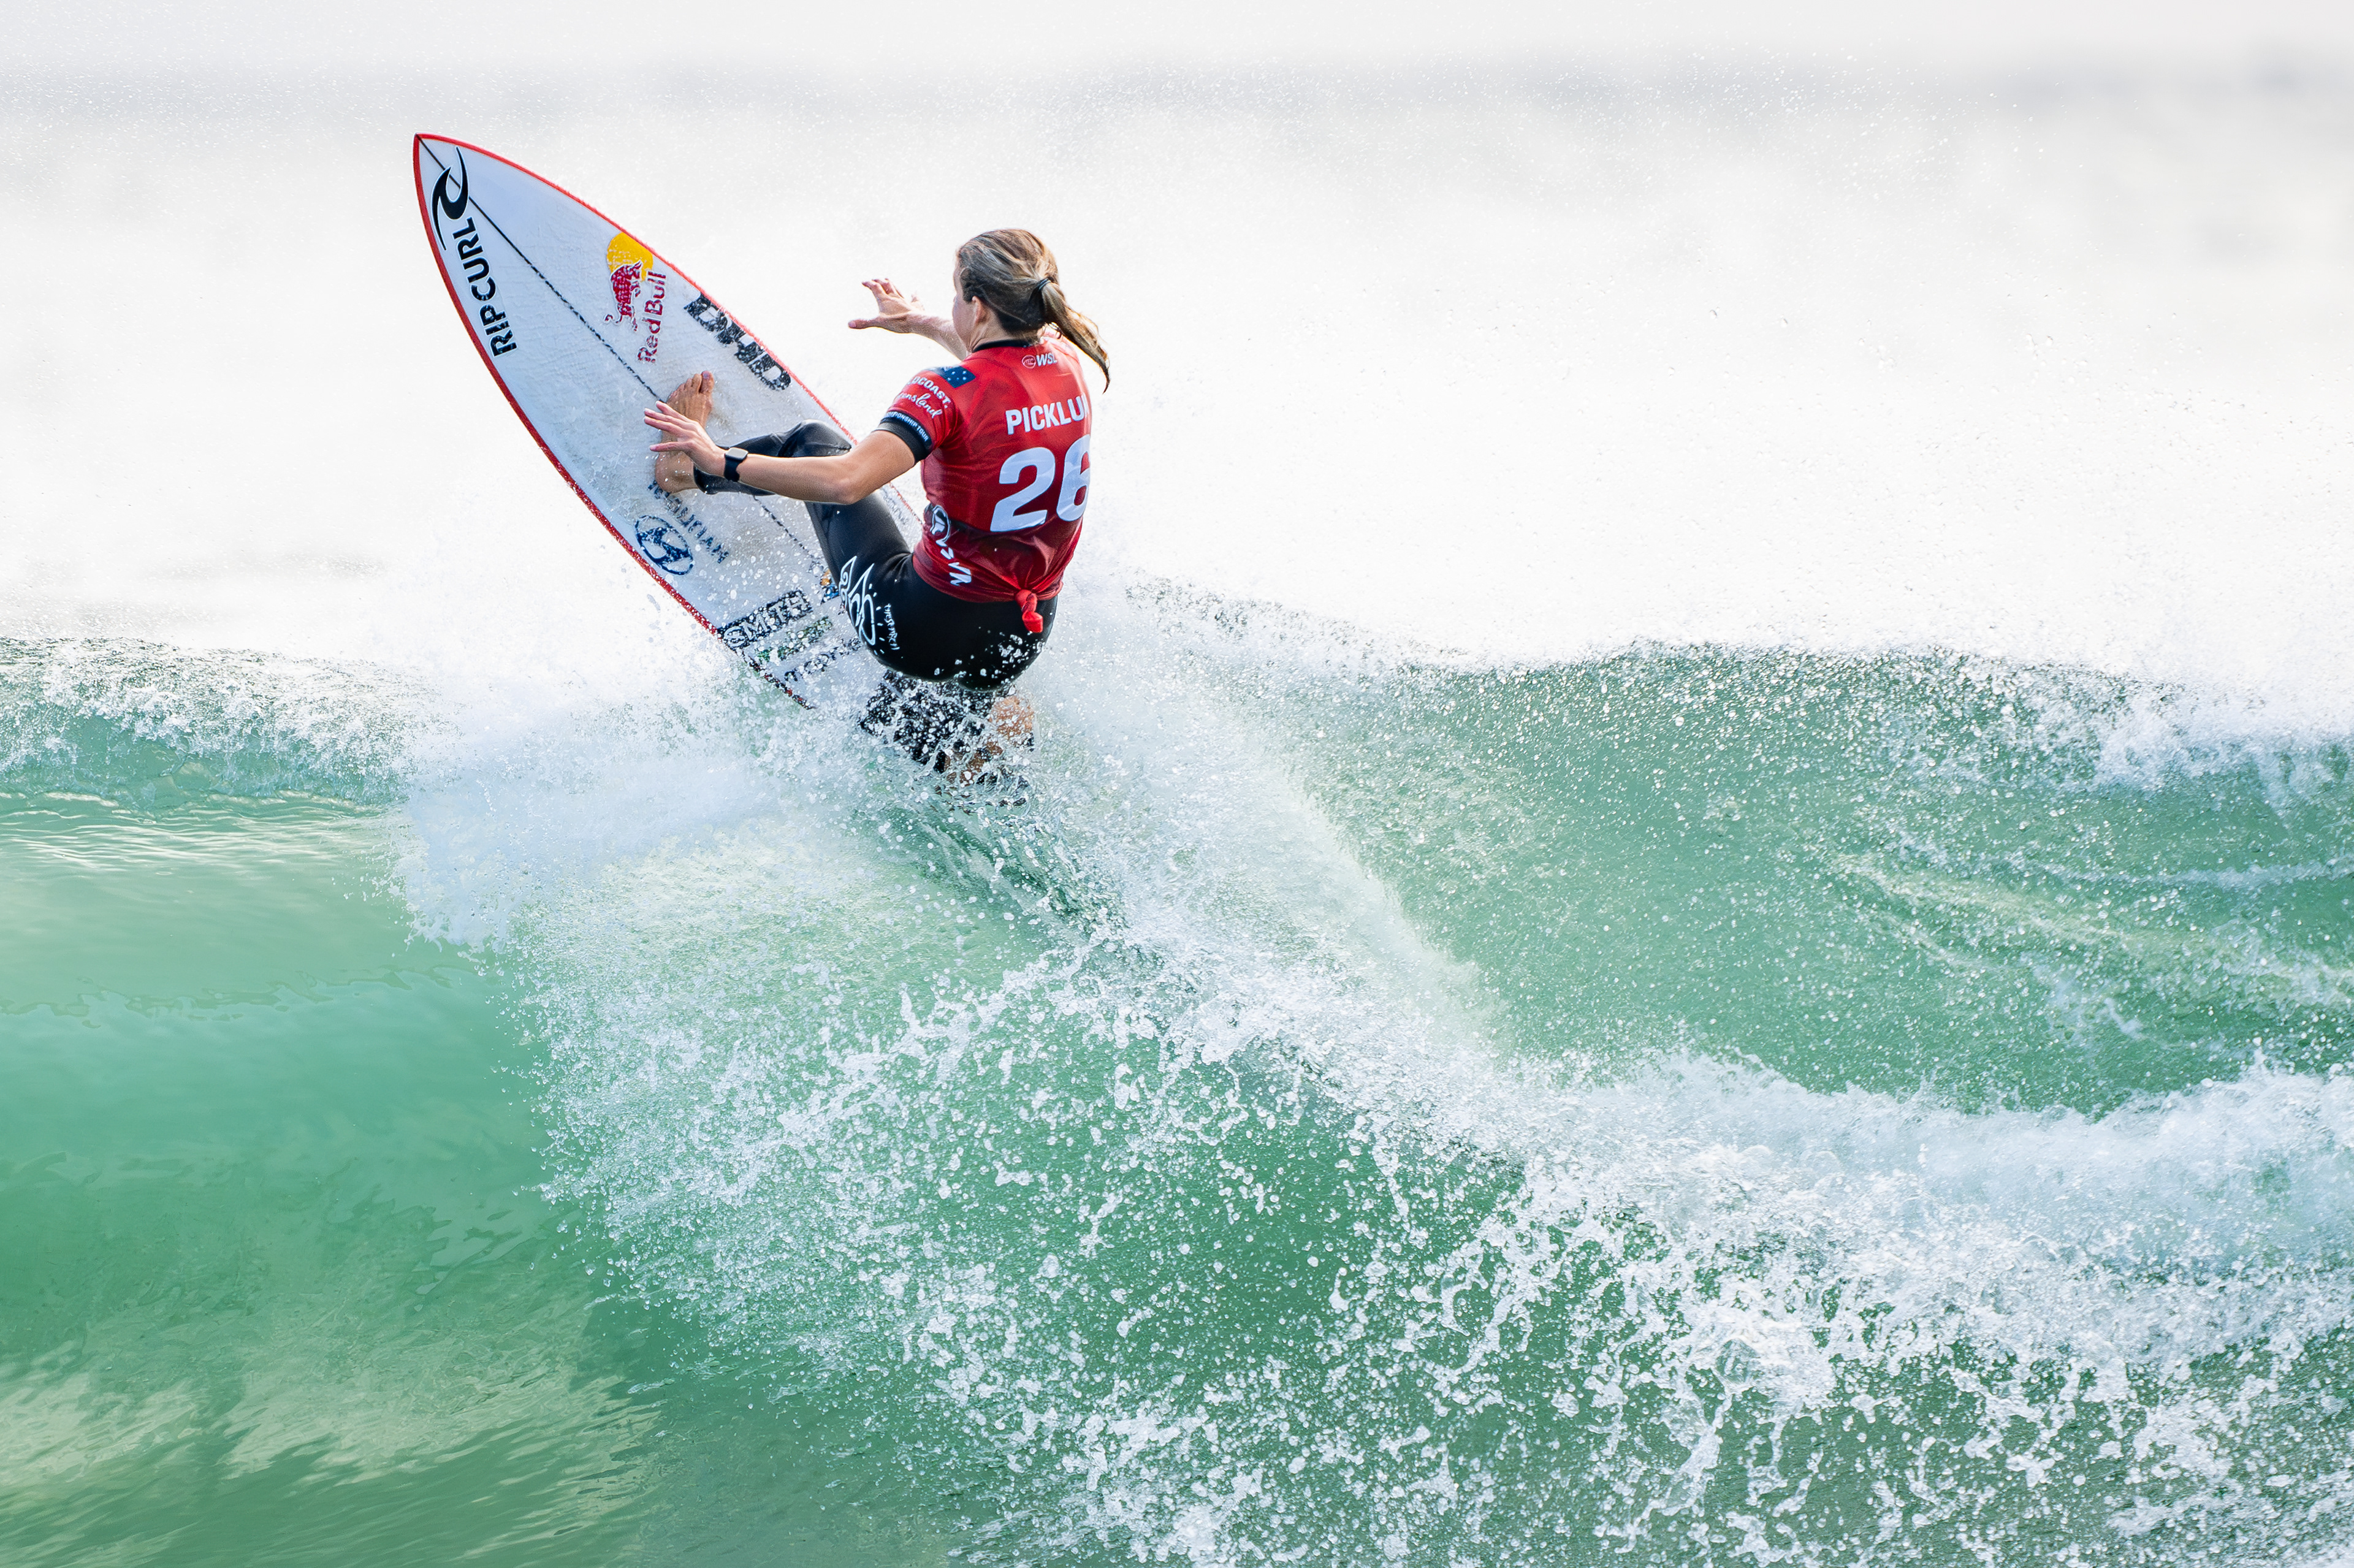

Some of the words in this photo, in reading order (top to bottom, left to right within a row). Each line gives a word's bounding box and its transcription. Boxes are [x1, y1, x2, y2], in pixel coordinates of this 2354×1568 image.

[452, 216, 496, 301] CURL
[644, 272, 666, 315] Bull
[479, 304, 517, 357] RIP
[638, 318, 661, 363] Red
[1036, 352, 1057, 367] WSL
[916, 425, 929, 442] TOUR
[990, 434, 1091, 532] 26
[723, 593, 808, 647] SMITH
